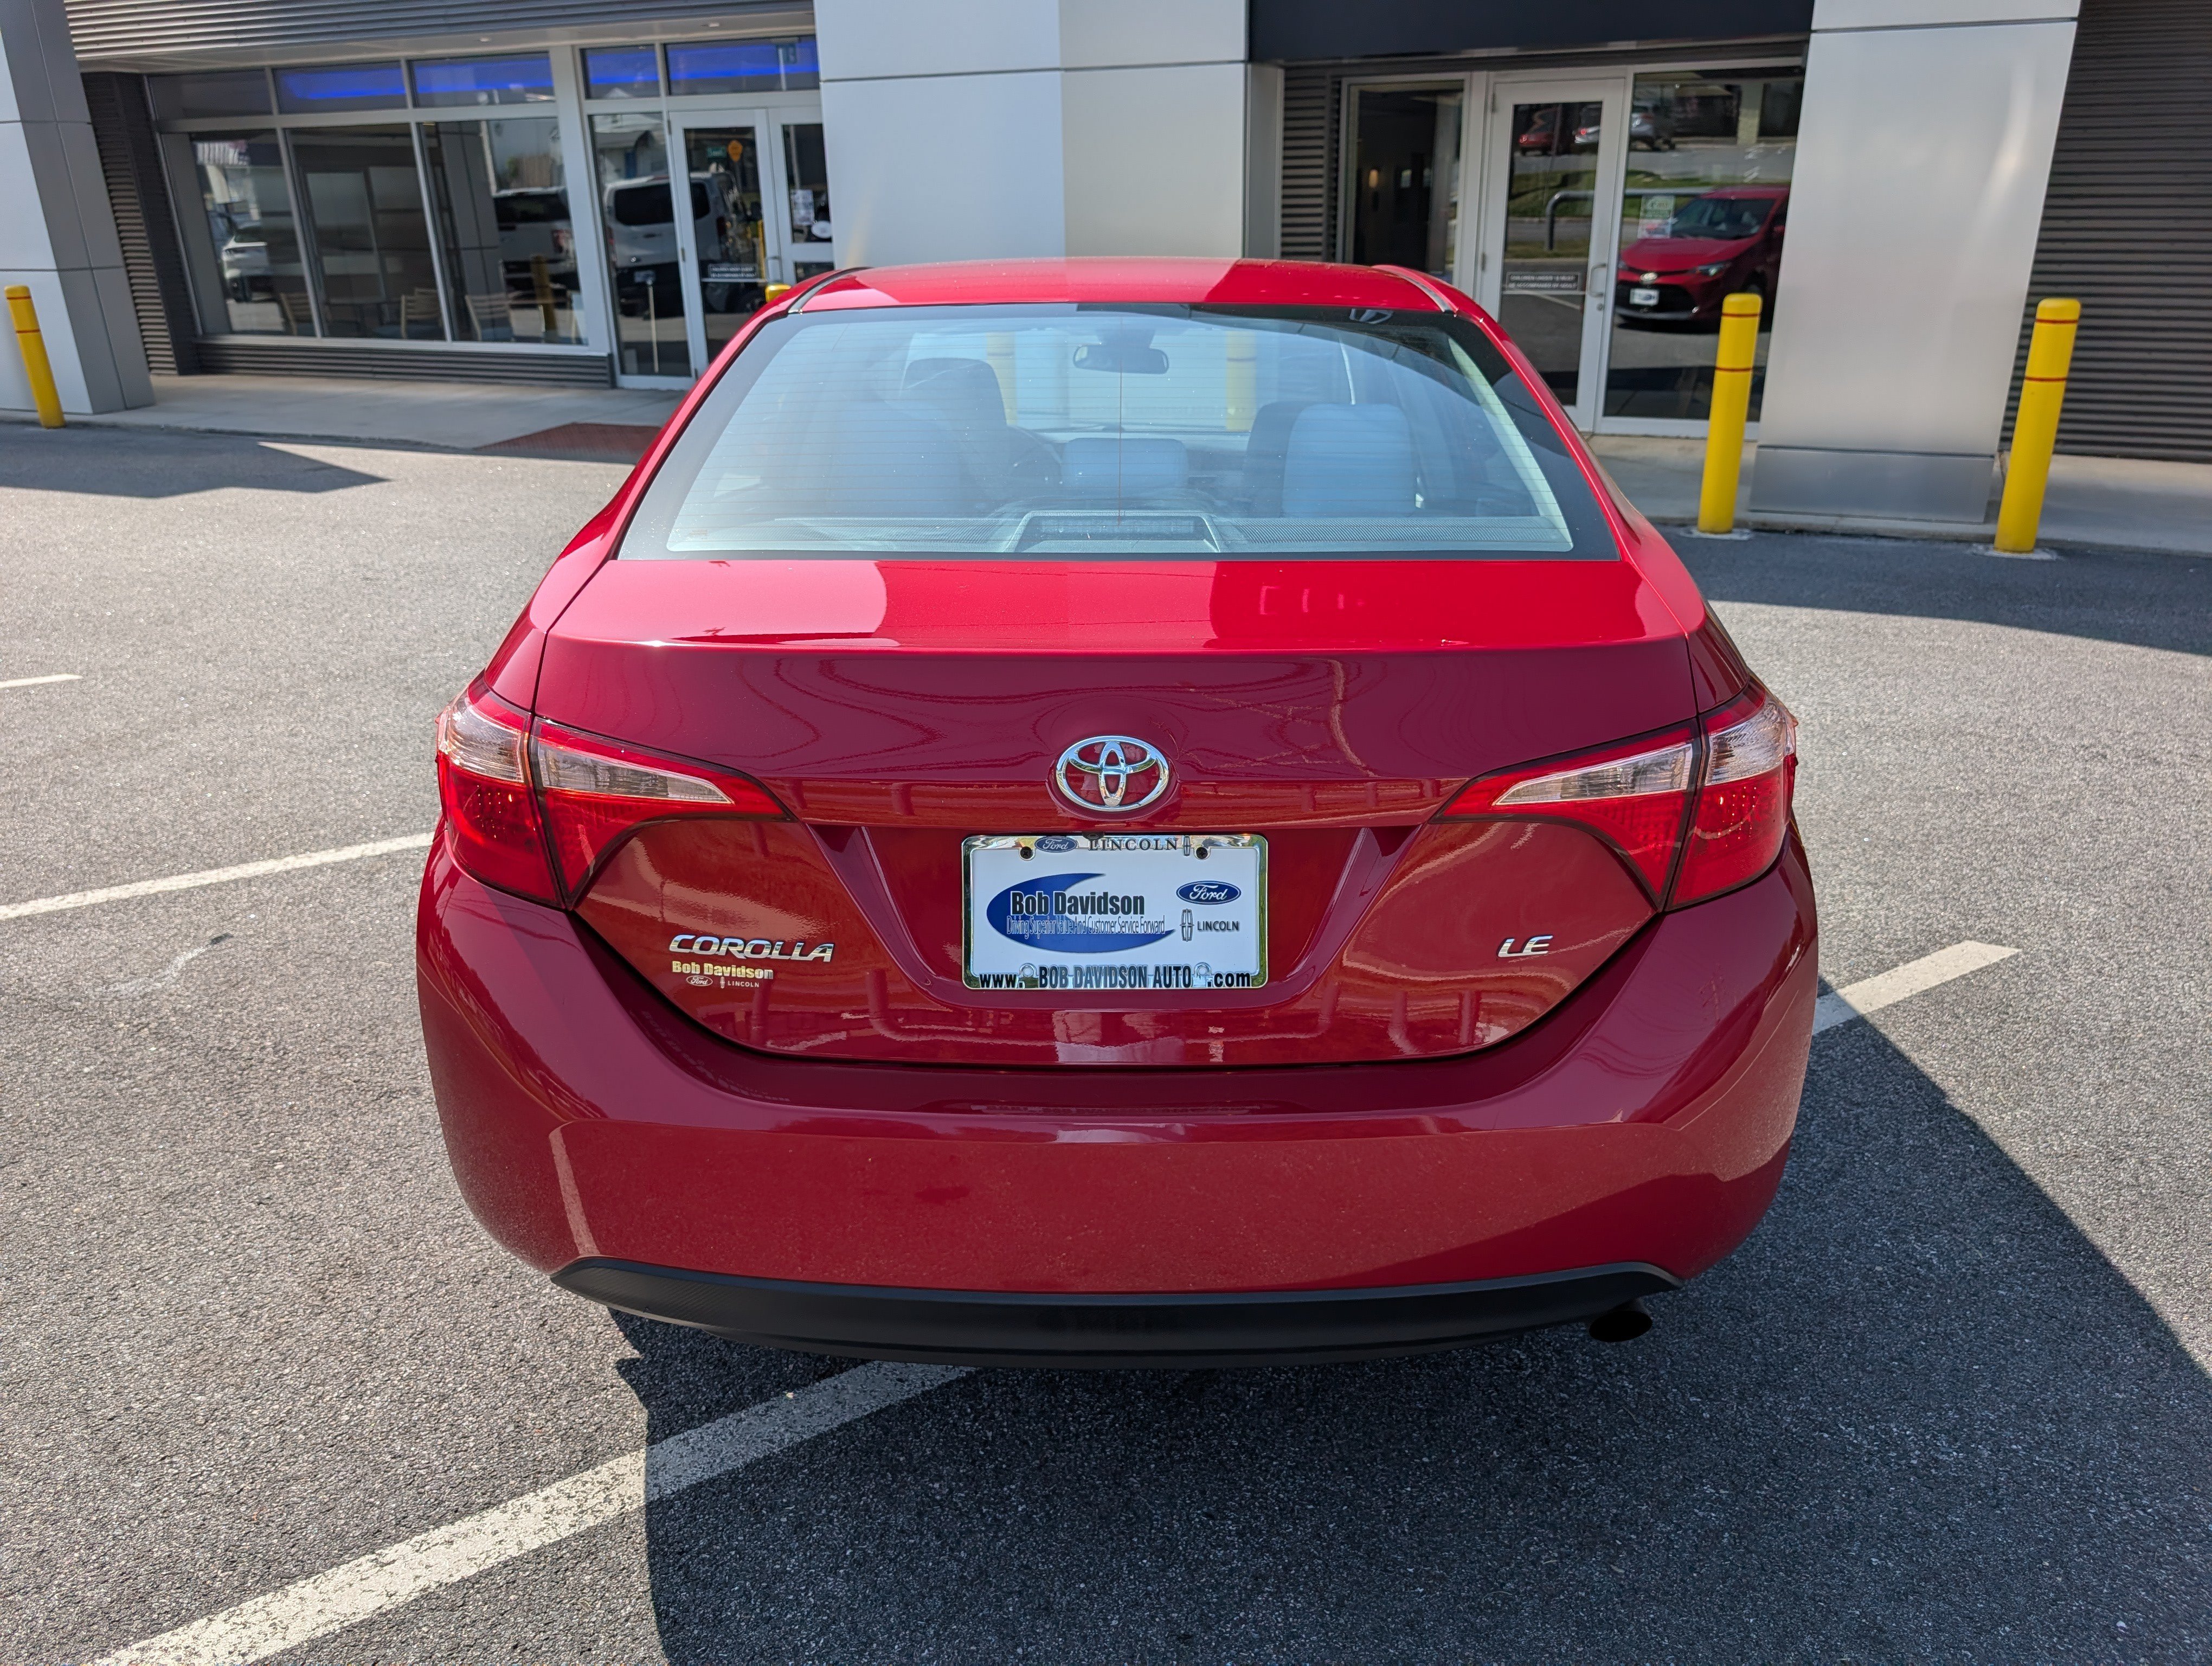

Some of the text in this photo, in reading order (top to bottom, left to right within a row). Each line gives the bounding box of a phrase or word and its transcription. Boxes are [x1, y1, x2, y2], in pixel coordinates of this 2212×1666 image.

[1042, 839, 1069, 850] Ford
[1088, 838, 1179, 851] LINCOLN
[1189, 884, 1229, 900] Ford
[1010, 890, 1145, 915] Bob Davidson
[1087, 916, 1117, 934] Customer
[1117, 916, 1139, 934] Service
[1140, 915, 1166, 934] Forward
[1197, 920, 1240, 932] LINCOLN
[669, 934, 835, 963] COROLLA
[1497, 935, 1554, 958] LE
[672, 960, 774, 979] Bob Davidson
[1039, 965, 1069, 989] BOB
[1073, 965, 1148, 988] DAVIDSON
[1153, 965, 1192, 988] AUTO
[690, 977, 709, 985] Ford
